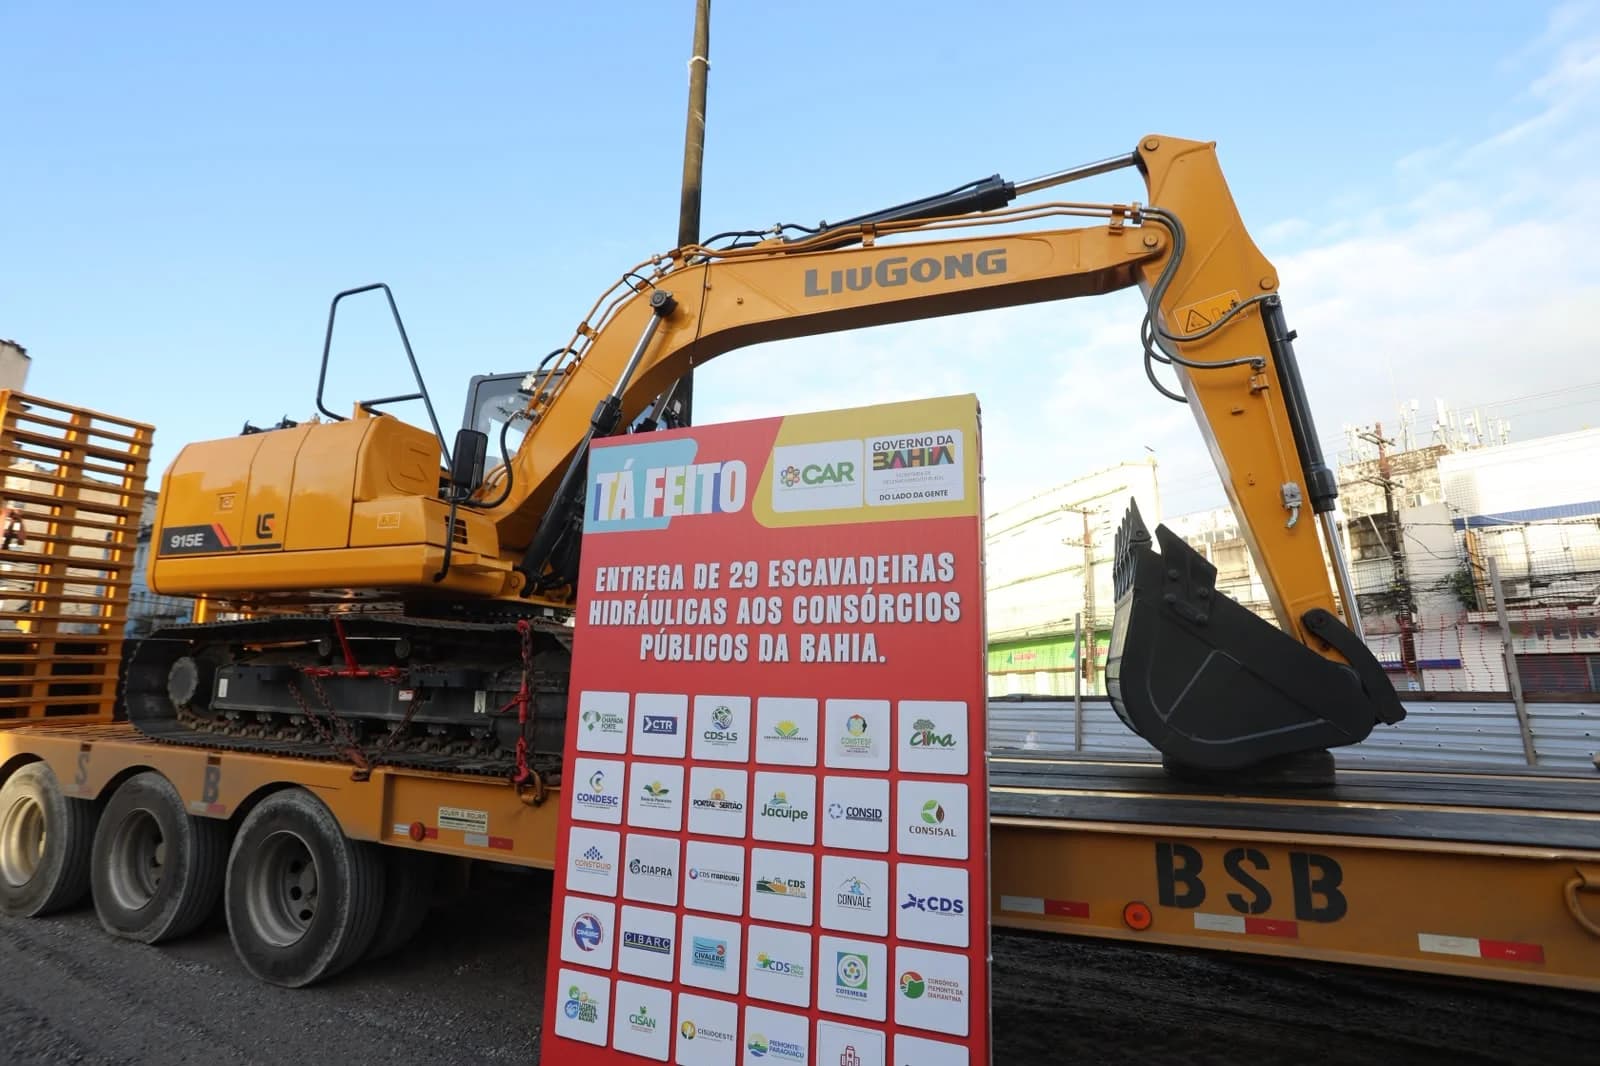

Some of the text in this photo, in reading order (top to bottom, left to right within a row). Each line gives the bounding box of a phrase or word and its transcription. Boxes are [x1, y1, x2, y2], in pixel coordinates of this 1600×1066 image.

[873, 435, 954, 452] GOVERNO DA
[801, 461, 855, 486] CAR
[595, 459, 748, 522] TÁ FEITO
[892, 492, 912, 500] LADO
[924, 489, 949, 498] GENTE
[170, 532, 205, 548] 915E
[595, 552, 955, 593] ENTREGA DE 29 ESCAVADEIRAS
[588, 587, 962, 626] HIDRÁULICAS AOS CONSÓRCIOS
[640, 628, 886, 663] PÚBLICOS DA BAHIA.
[652, 719, 673, 730] CTR
[704, 731, 738, 741] CDS-LS
[576, 792, 619, 805] CONDESC
[845, 806, 883, 819] CONSID
[908, 825, 957, 838] CONSISAL
[641, 864, 673, 877] CIAPRA
[787, 879, 806, 889] CDS
[837, 893, 872, 909] CONVALE
[926, 896, 964, 914] CDS
[624, 932, 671, 949] CIBARC
[768, 960, 790, 973] CDS
[629, 1013, 656, 1029] CISAN
